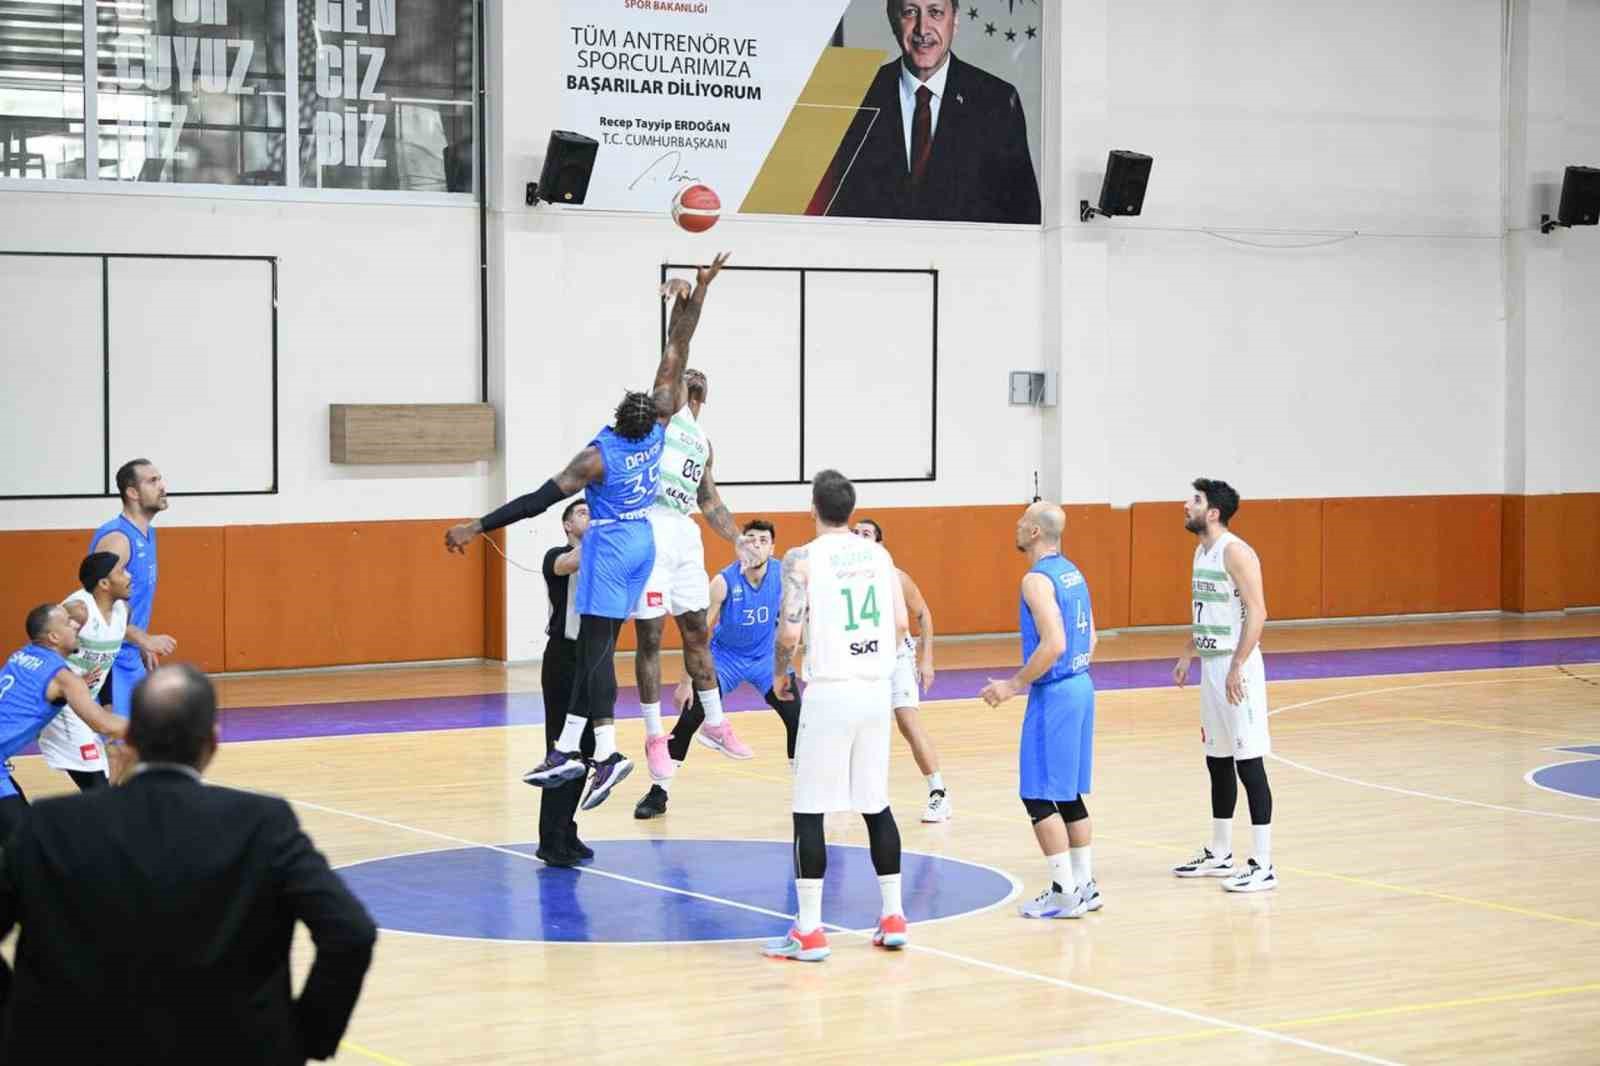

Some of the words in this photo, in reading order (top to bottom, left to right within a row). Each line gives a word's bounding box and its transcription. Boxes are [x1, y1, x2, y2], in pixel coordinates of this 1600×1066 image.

[570, 25, 616, 46] TÜM
[622, 31, 730, 55] ANTRENÖR
[734, 39, 758, 57] VE
[577, 50, 751, 79] SPORCULARIMIZA
[567, 75, 664, 96] BAŞARILAR
[668, 78, 761, 101] DİLİYORUM
[599, 117, 633, 130] Recep
[635, 118, 672, 132] Tayyip
[674, 119, 731, 133] ERDOĞAN
[602, 133, 623, 146] T.C.
[625, 134, 727, 151] CUMHURBAŞKANI
[742, 606, 769, 626] 30
[840, 584, 880, 631] 14
[1076, 599, 1089, 634] 4
